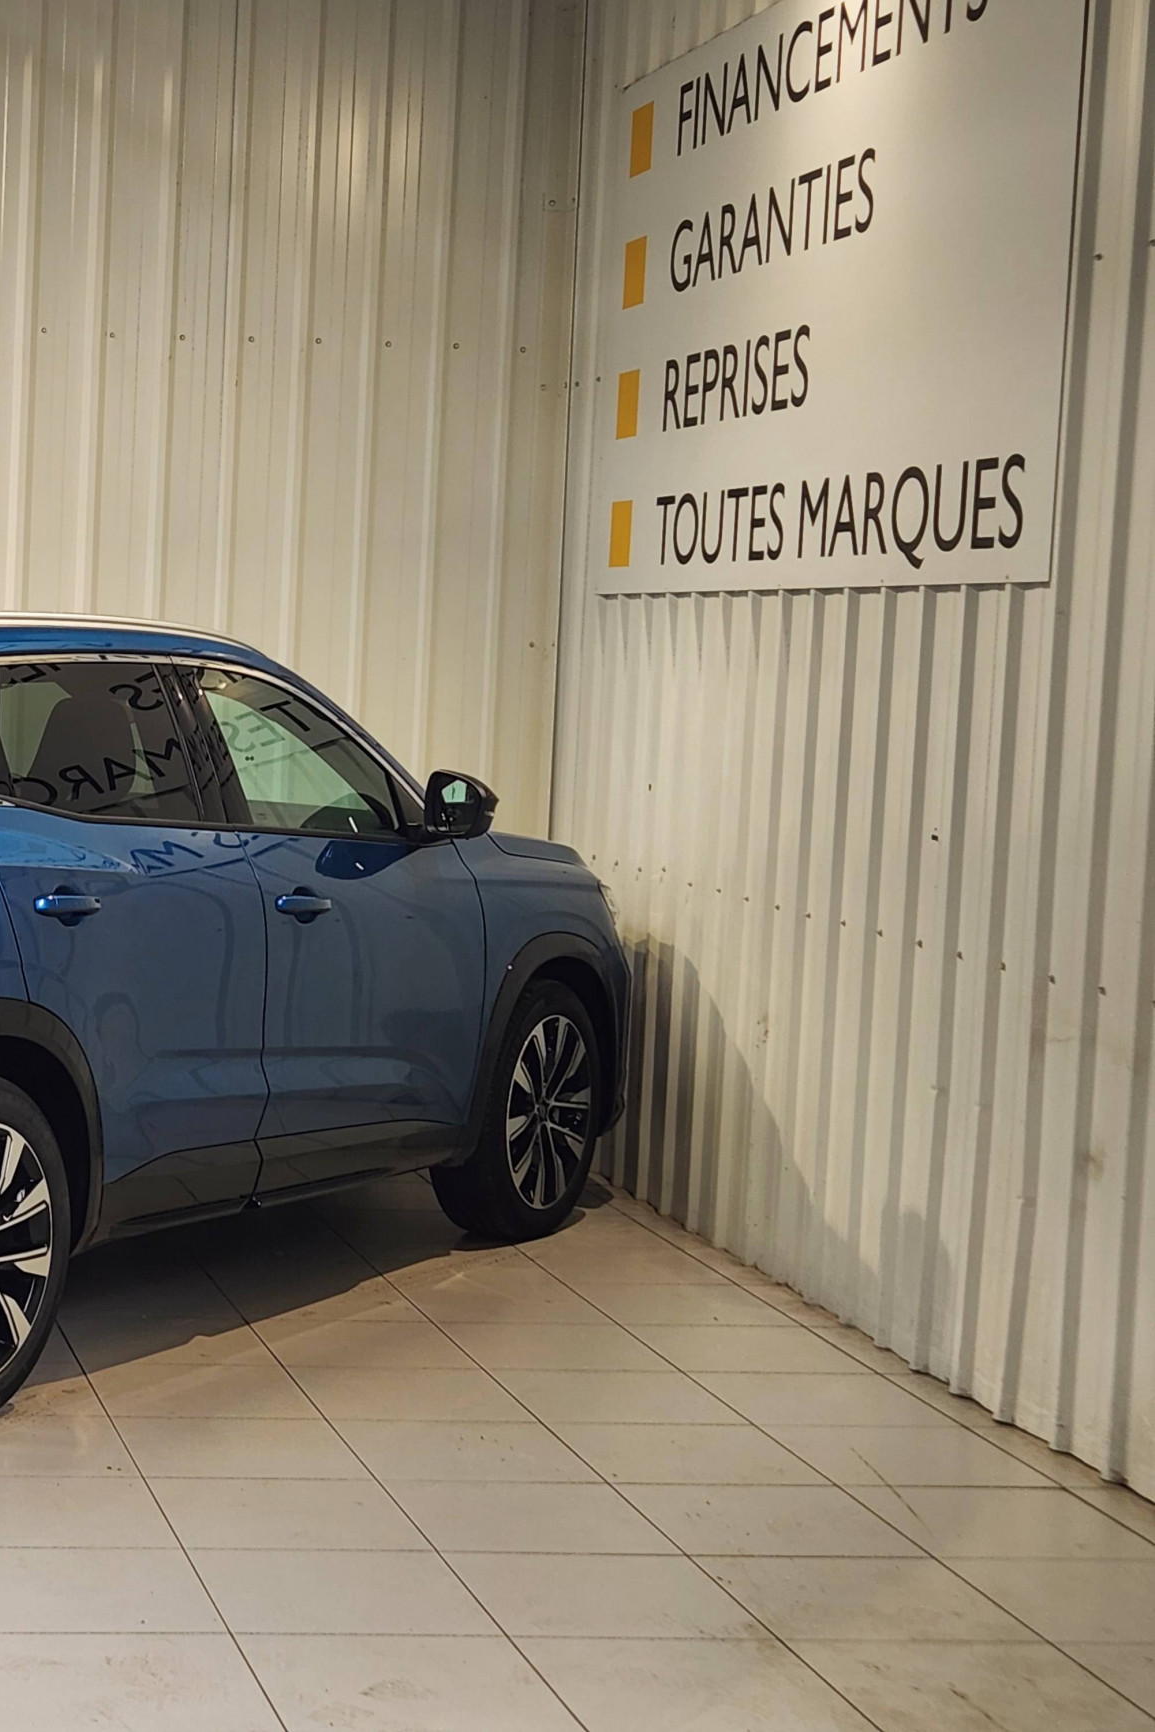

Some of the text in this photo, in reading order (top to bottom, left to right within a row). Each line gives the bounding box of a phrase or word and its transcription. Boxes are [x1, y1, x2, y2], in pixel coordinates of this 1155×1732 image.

[676, 0, 989, 157] FINANCEMEN
[669, 147, 876, 293] GARANTIES
[661, 324, 811, 432] REPRISES
[656, 453, 1026, 570] TOUTES MARQUES
